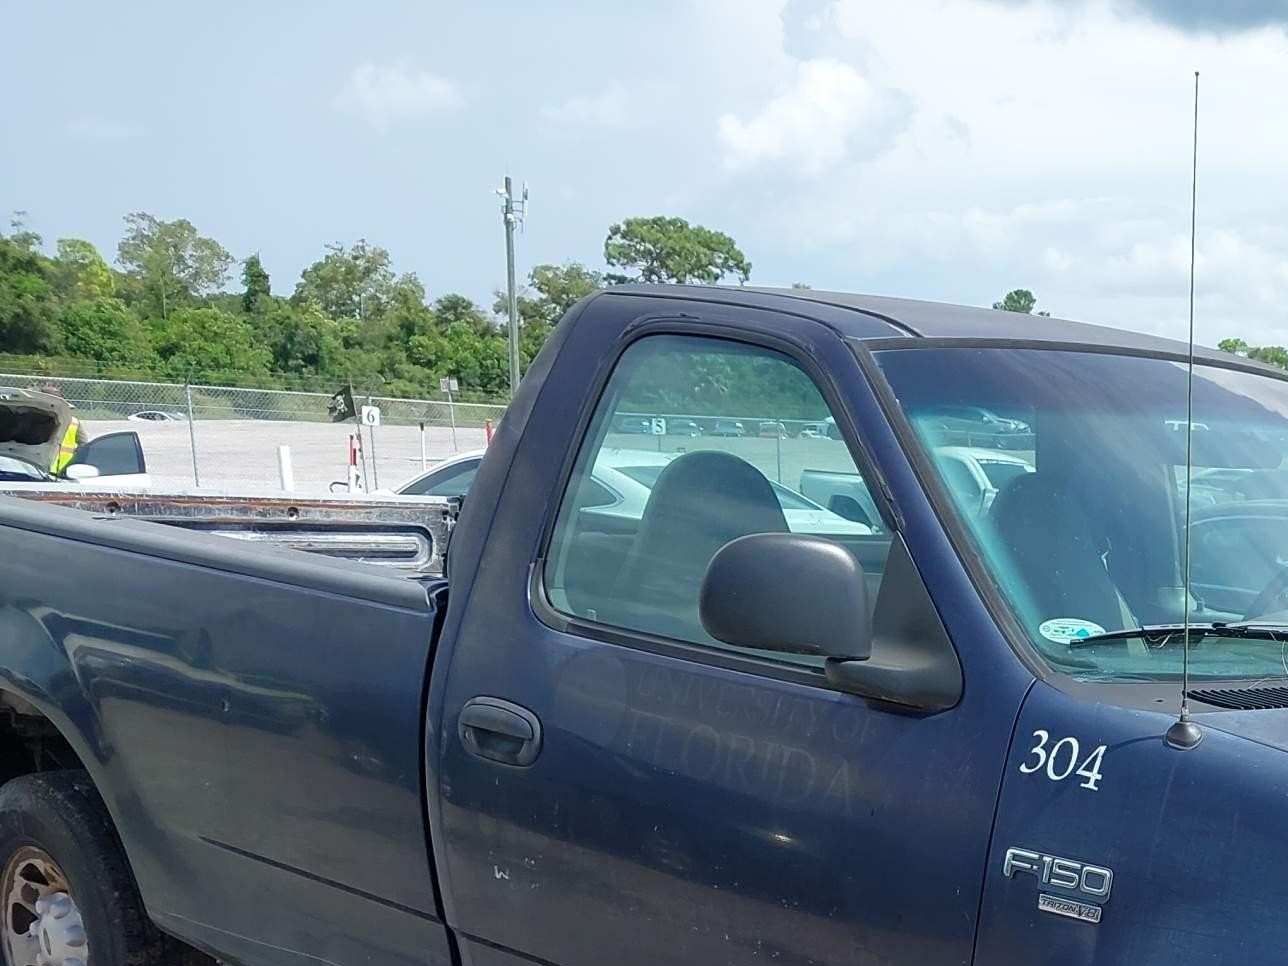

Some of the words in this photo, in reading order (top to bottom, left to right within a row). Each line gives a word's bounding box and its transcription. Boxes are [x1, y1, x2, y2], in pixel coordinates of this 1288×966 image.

[366, 408, 376, 424] 6
[655, 419, 663, 433] 5
[625, 708, 856, 816] FLORIDA
[1019, 729, 1108, 791] 304
